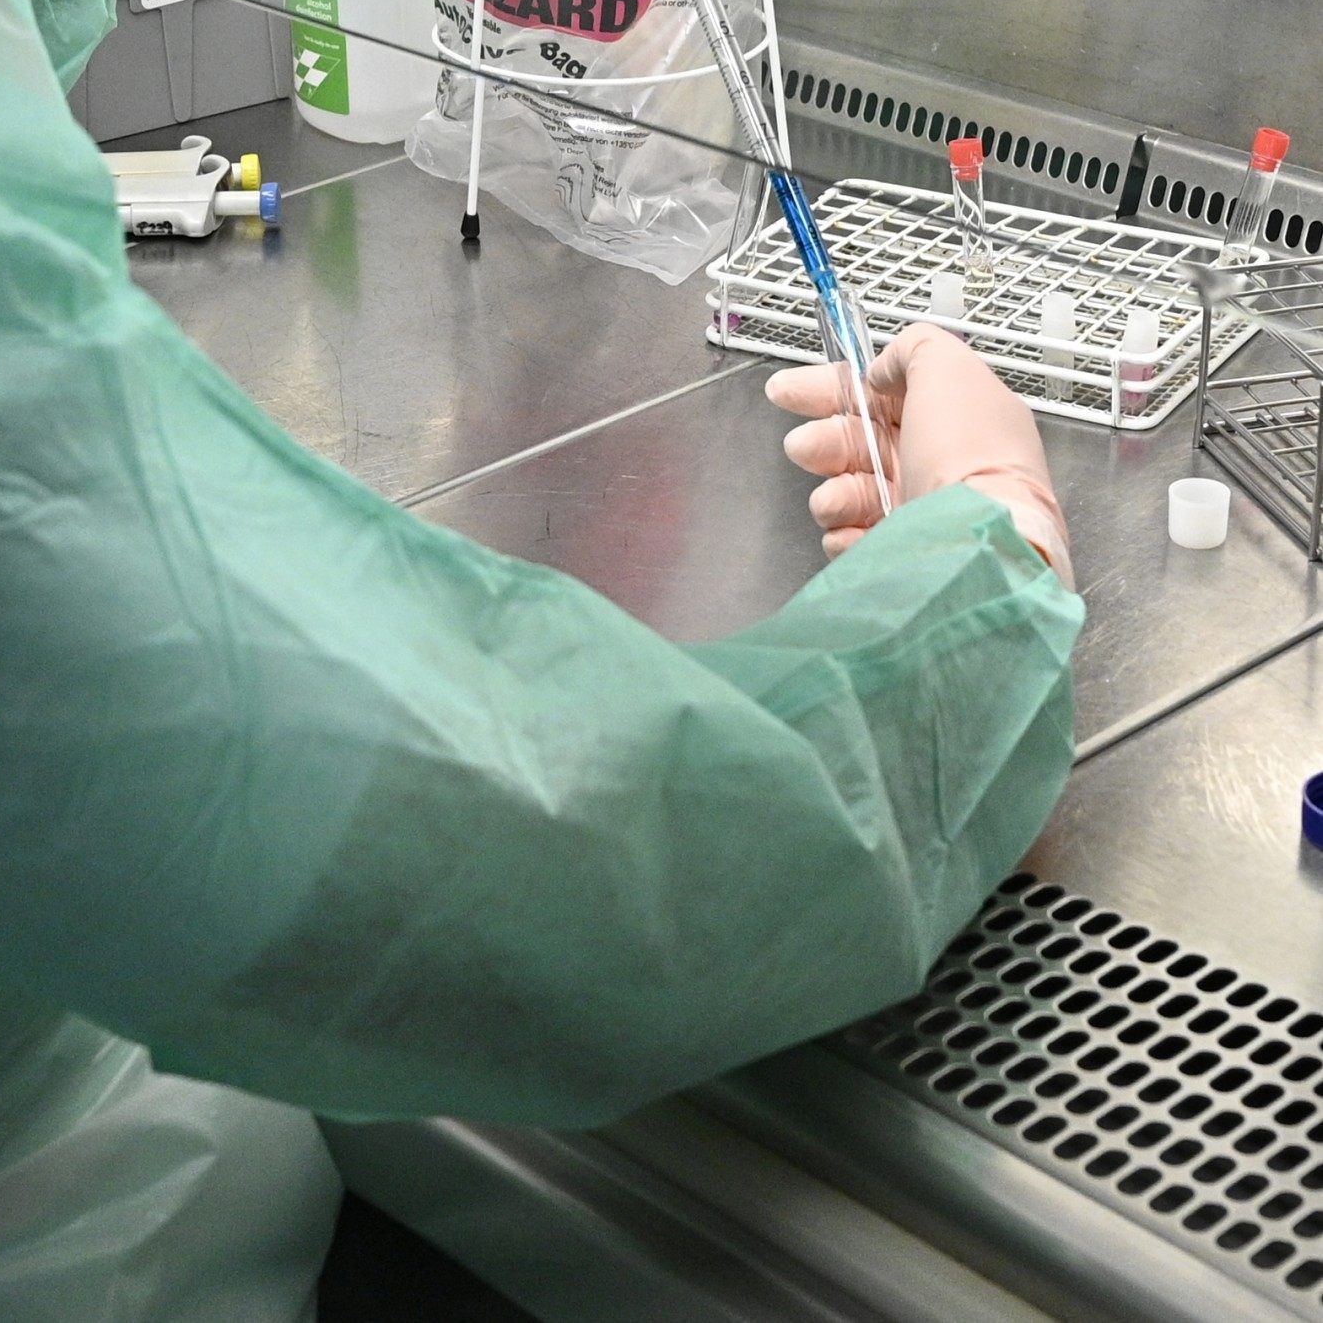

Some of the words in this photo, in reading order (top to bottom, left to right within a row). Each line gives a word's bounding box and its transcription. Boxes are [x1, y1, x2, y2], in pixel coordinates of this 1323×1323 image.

[719, 20, 730, 35] 5
[540, 40, 589, 79] Bag
[739, 70, 750, 86] 6
